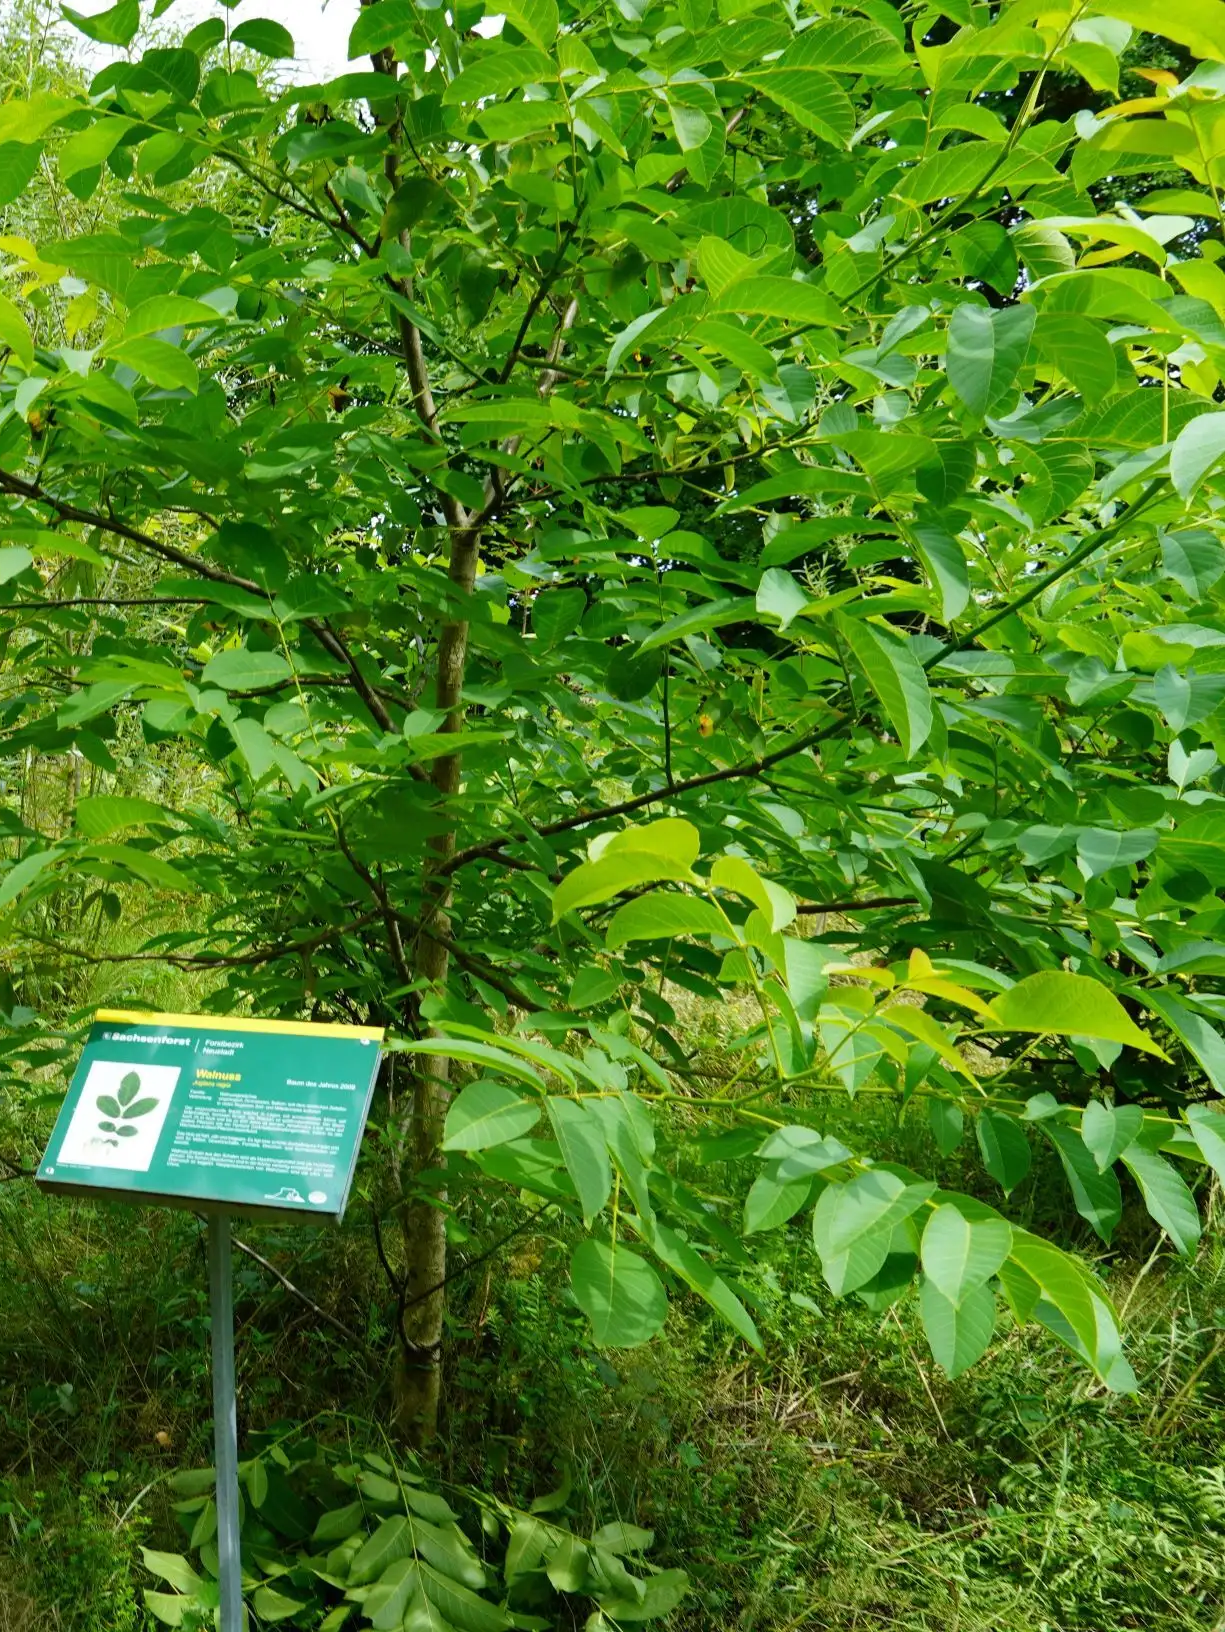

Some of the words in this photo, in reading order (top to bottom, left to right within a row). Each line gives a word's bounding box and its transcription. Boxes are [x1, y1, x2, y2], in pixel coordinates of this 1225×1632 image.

[112, 1033, 191, 1046] Sachsenforst
[205, 1039, 244, 1049] Forstbezirk
[202, 1047, 235, 1056] Neustadt
[196, 1068, 242, 1082] Walnuss
[286, 1078, 304, 1086] Baum
[318, 1081, 339, 1089] Jahres
